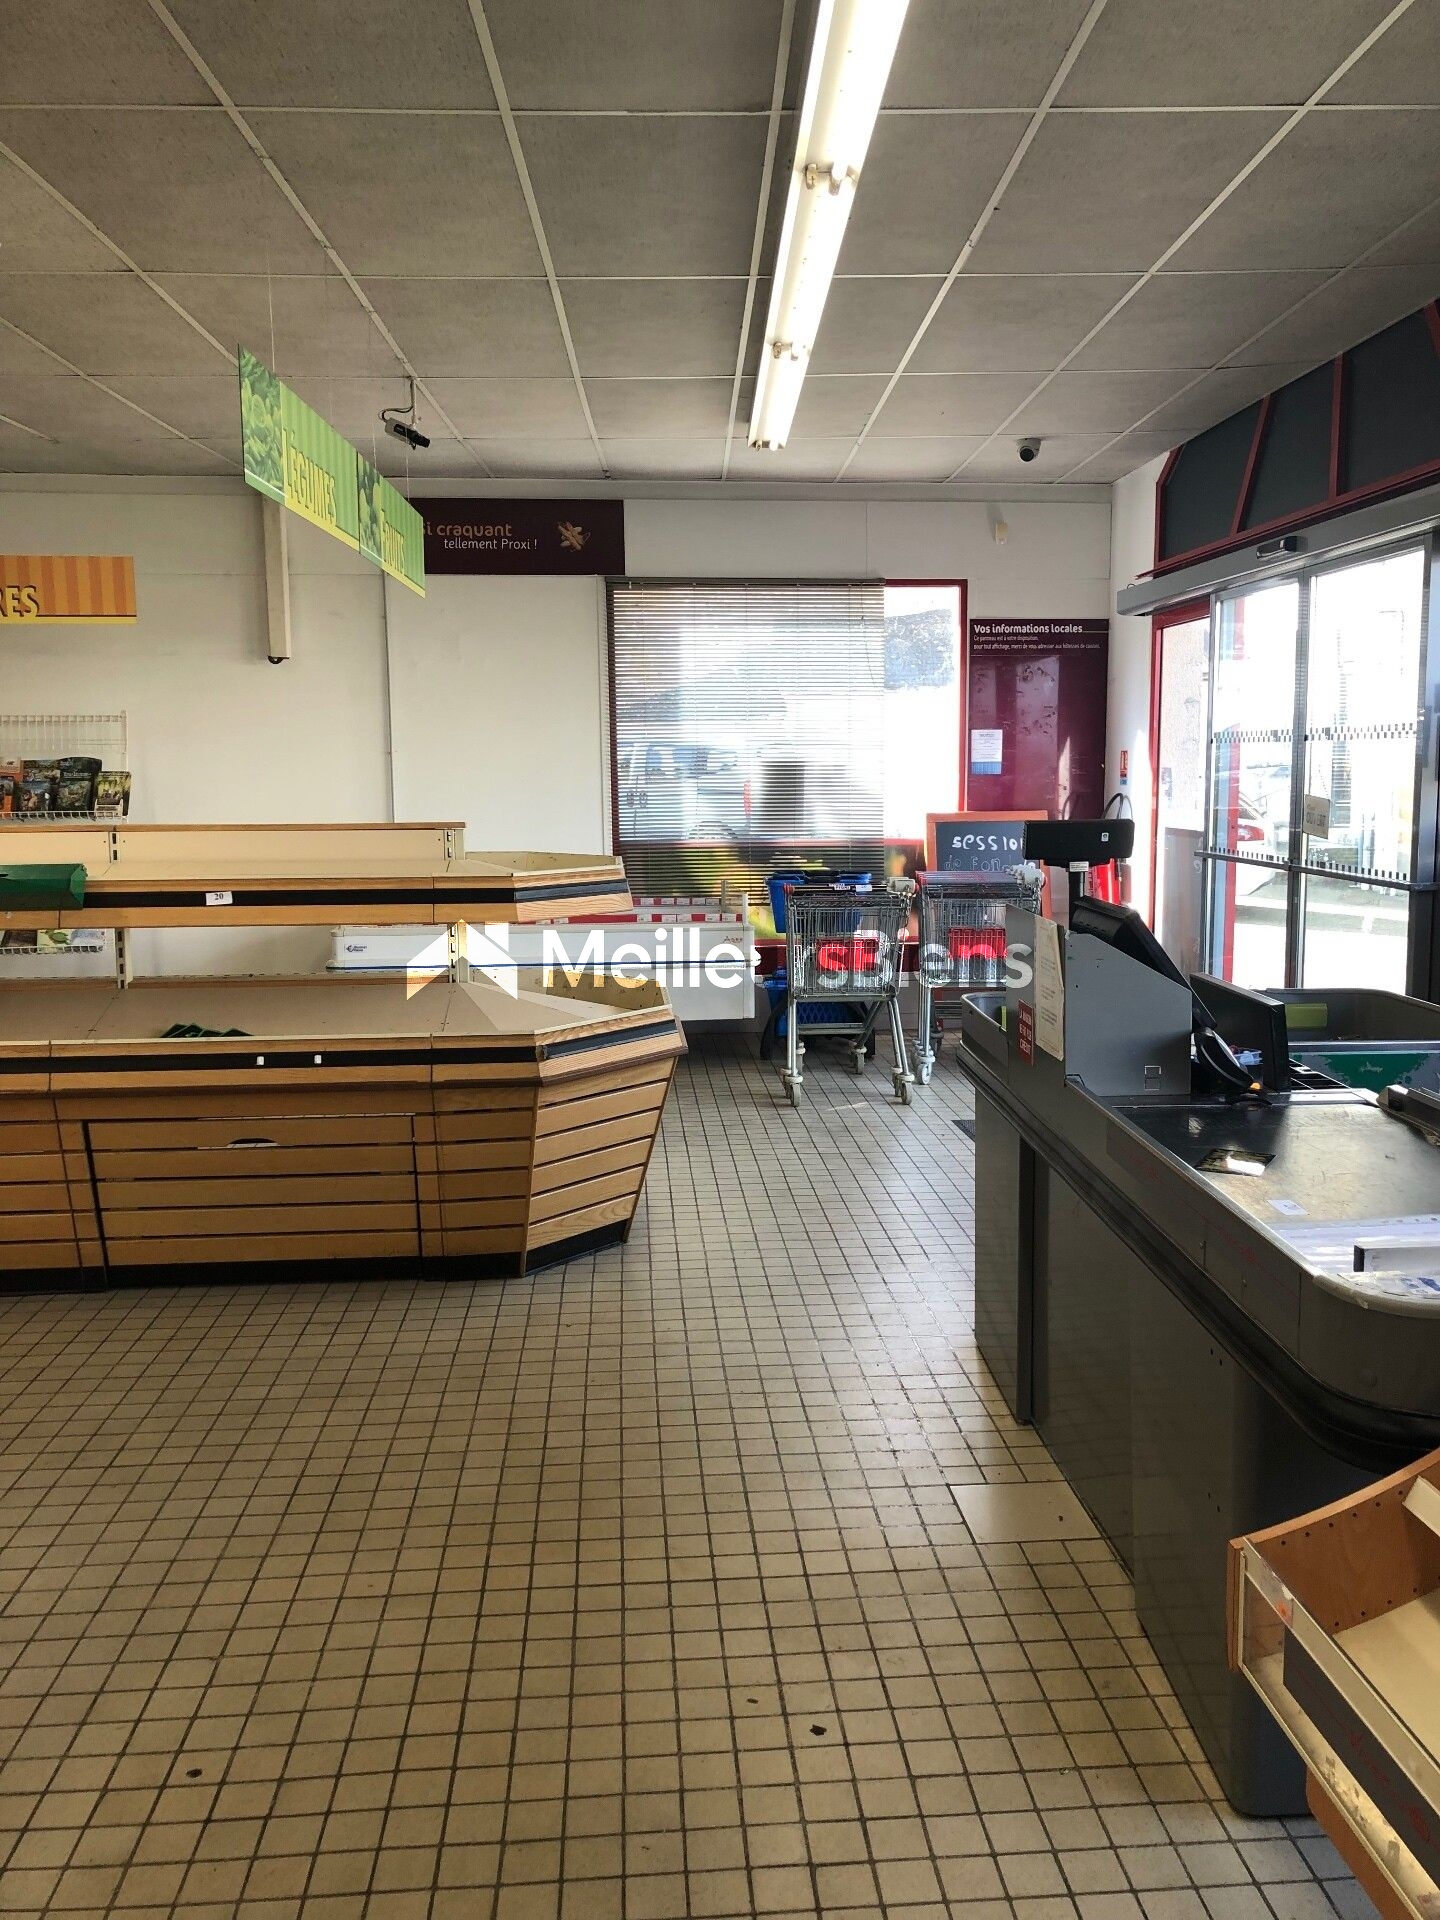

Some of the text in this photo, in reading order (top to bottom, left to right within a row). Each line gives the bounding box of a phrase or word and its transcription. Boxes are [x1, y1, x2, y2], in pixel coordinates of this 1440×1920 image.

[423, 521, 513, 538] i craquant
[444, 538, 538, 550] tellement Proxi !
[974, 623, 1082, 633] Vos informations locales
[952, 834, 1023, 851] sessio
[214, 892, 224, 901] 20
